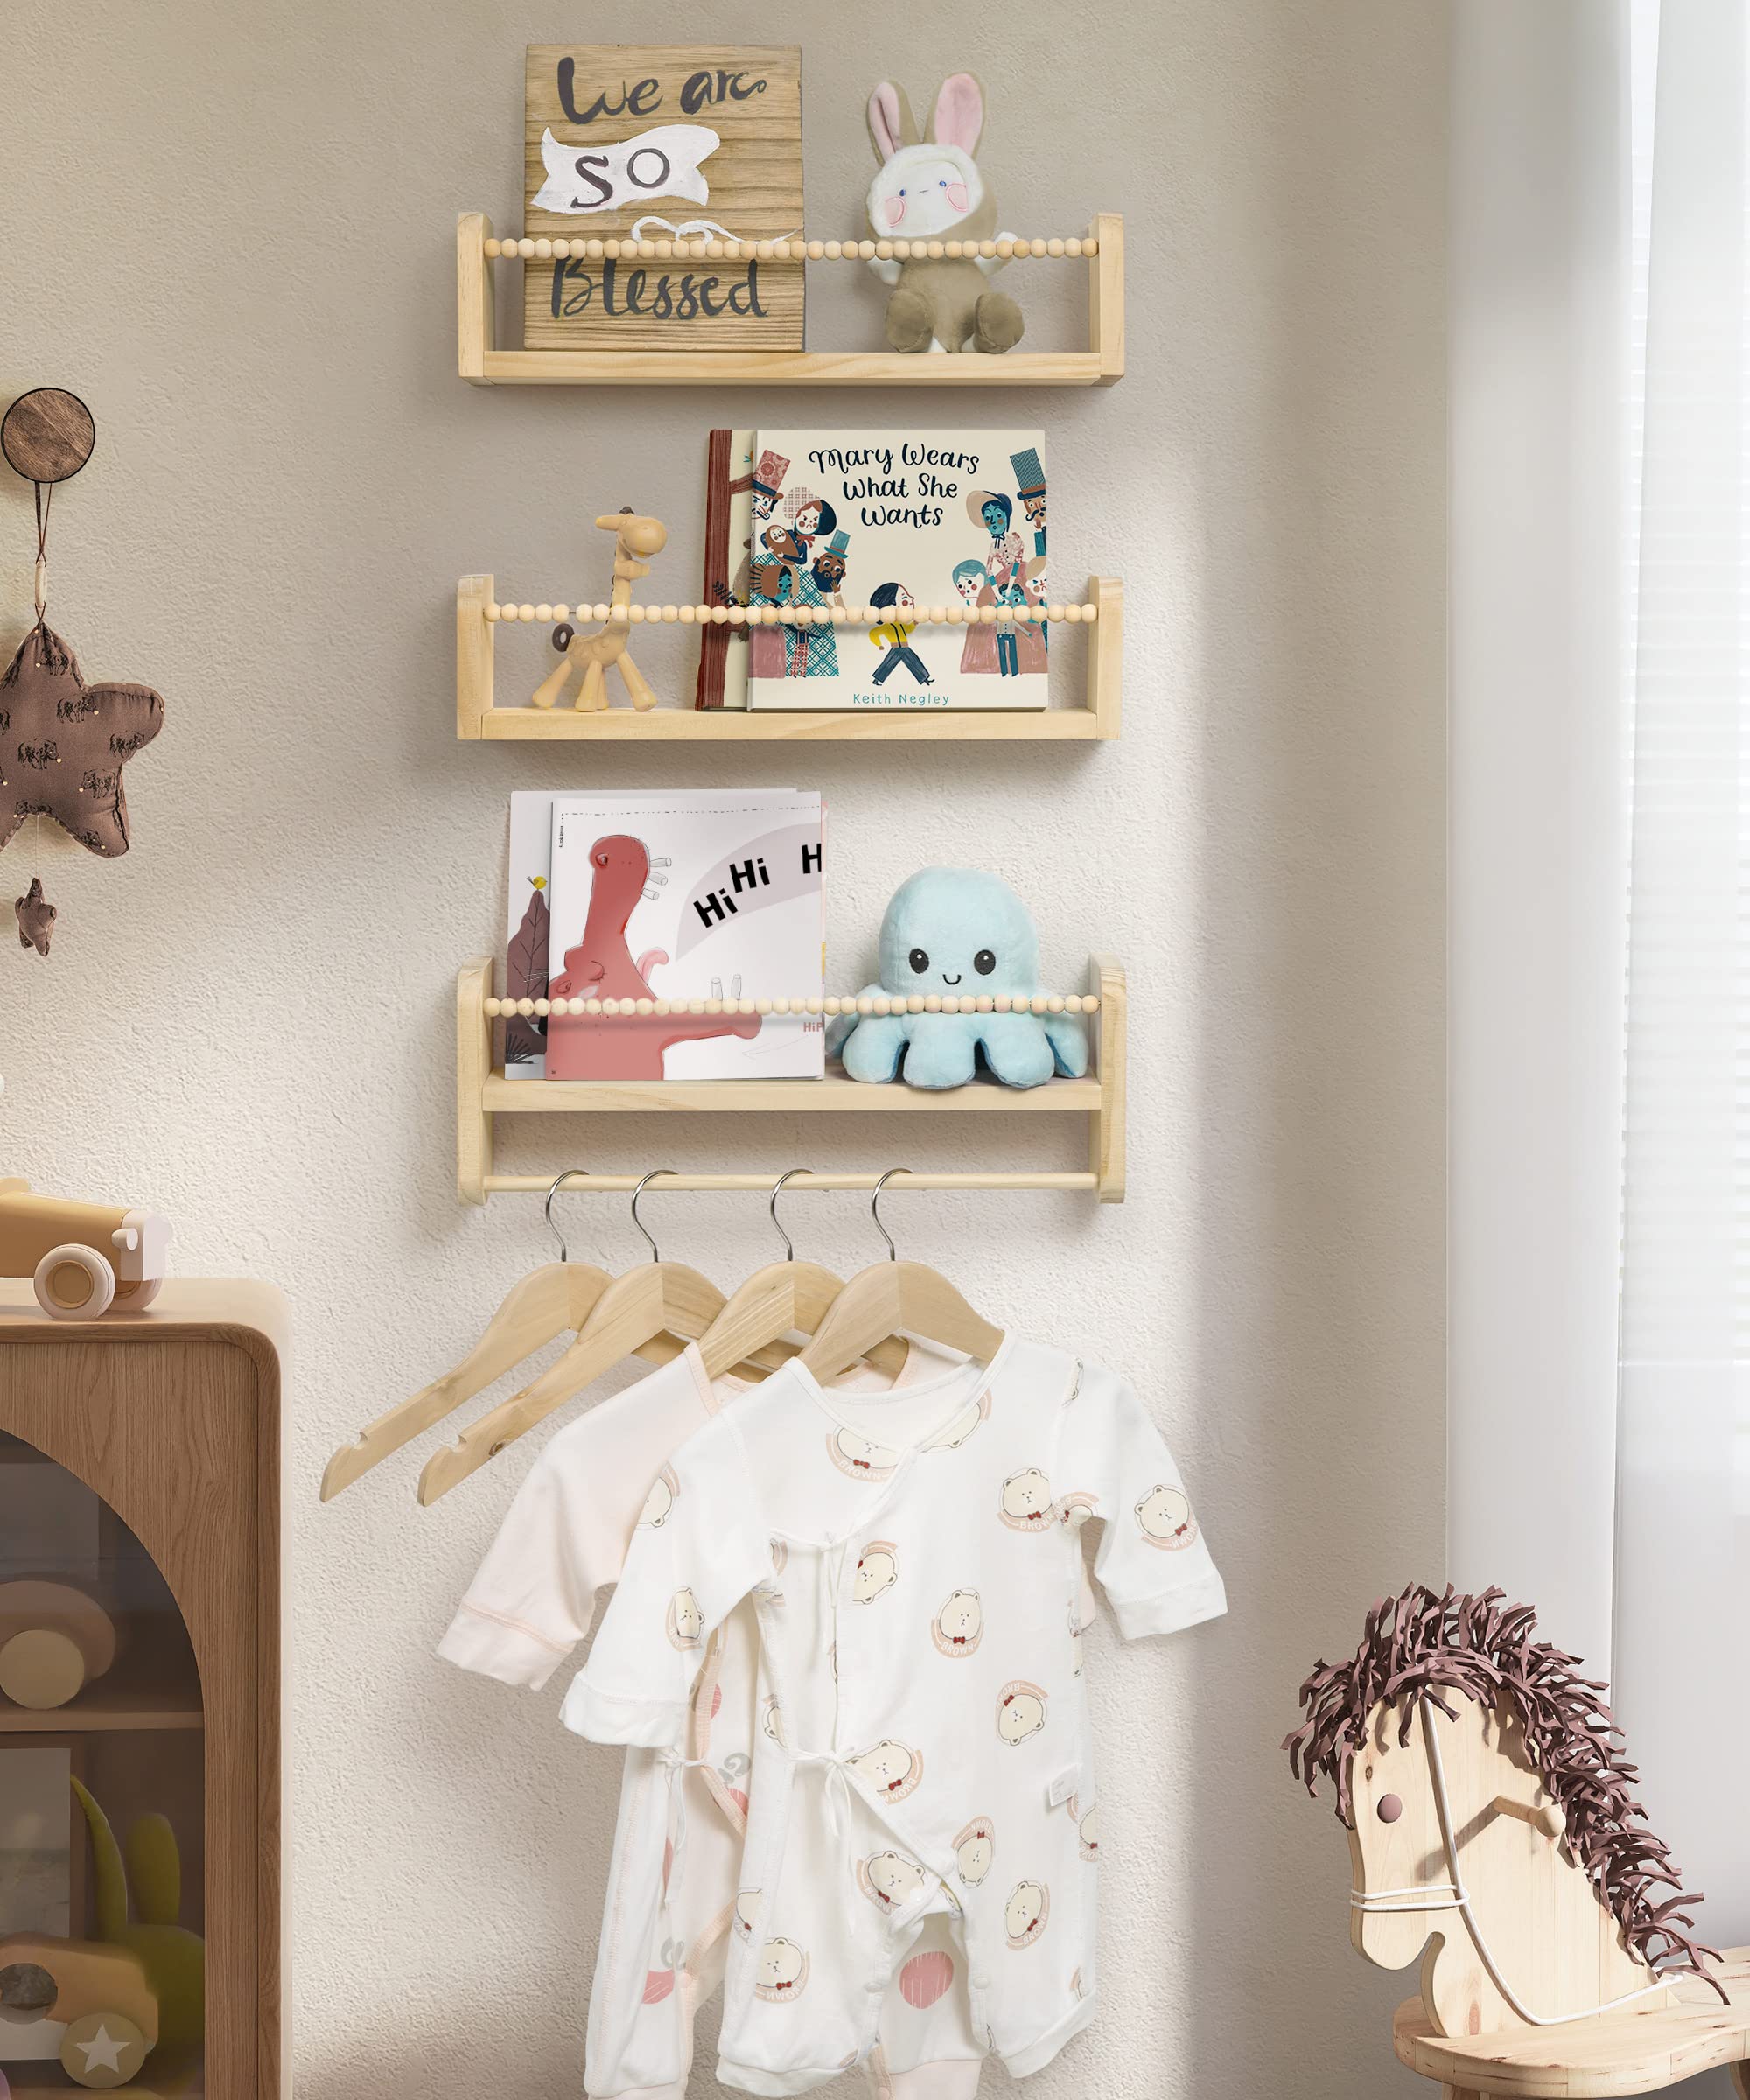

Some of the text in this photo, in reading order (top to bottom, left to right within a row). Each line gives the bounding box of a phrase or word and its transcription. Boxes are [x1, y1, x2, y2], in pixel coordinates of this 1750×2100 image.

[551, 255, 768, 320] Blessed
[808, 443, 980, 475] Mary Wears
[843, 472, 957, 500] What She
[861, 504, 943, 529] Wants
[853, 693, 949, 706] Keith Negley
[693, 887, 738, 928] Hi
[729, 858, 770, 893] Hi
